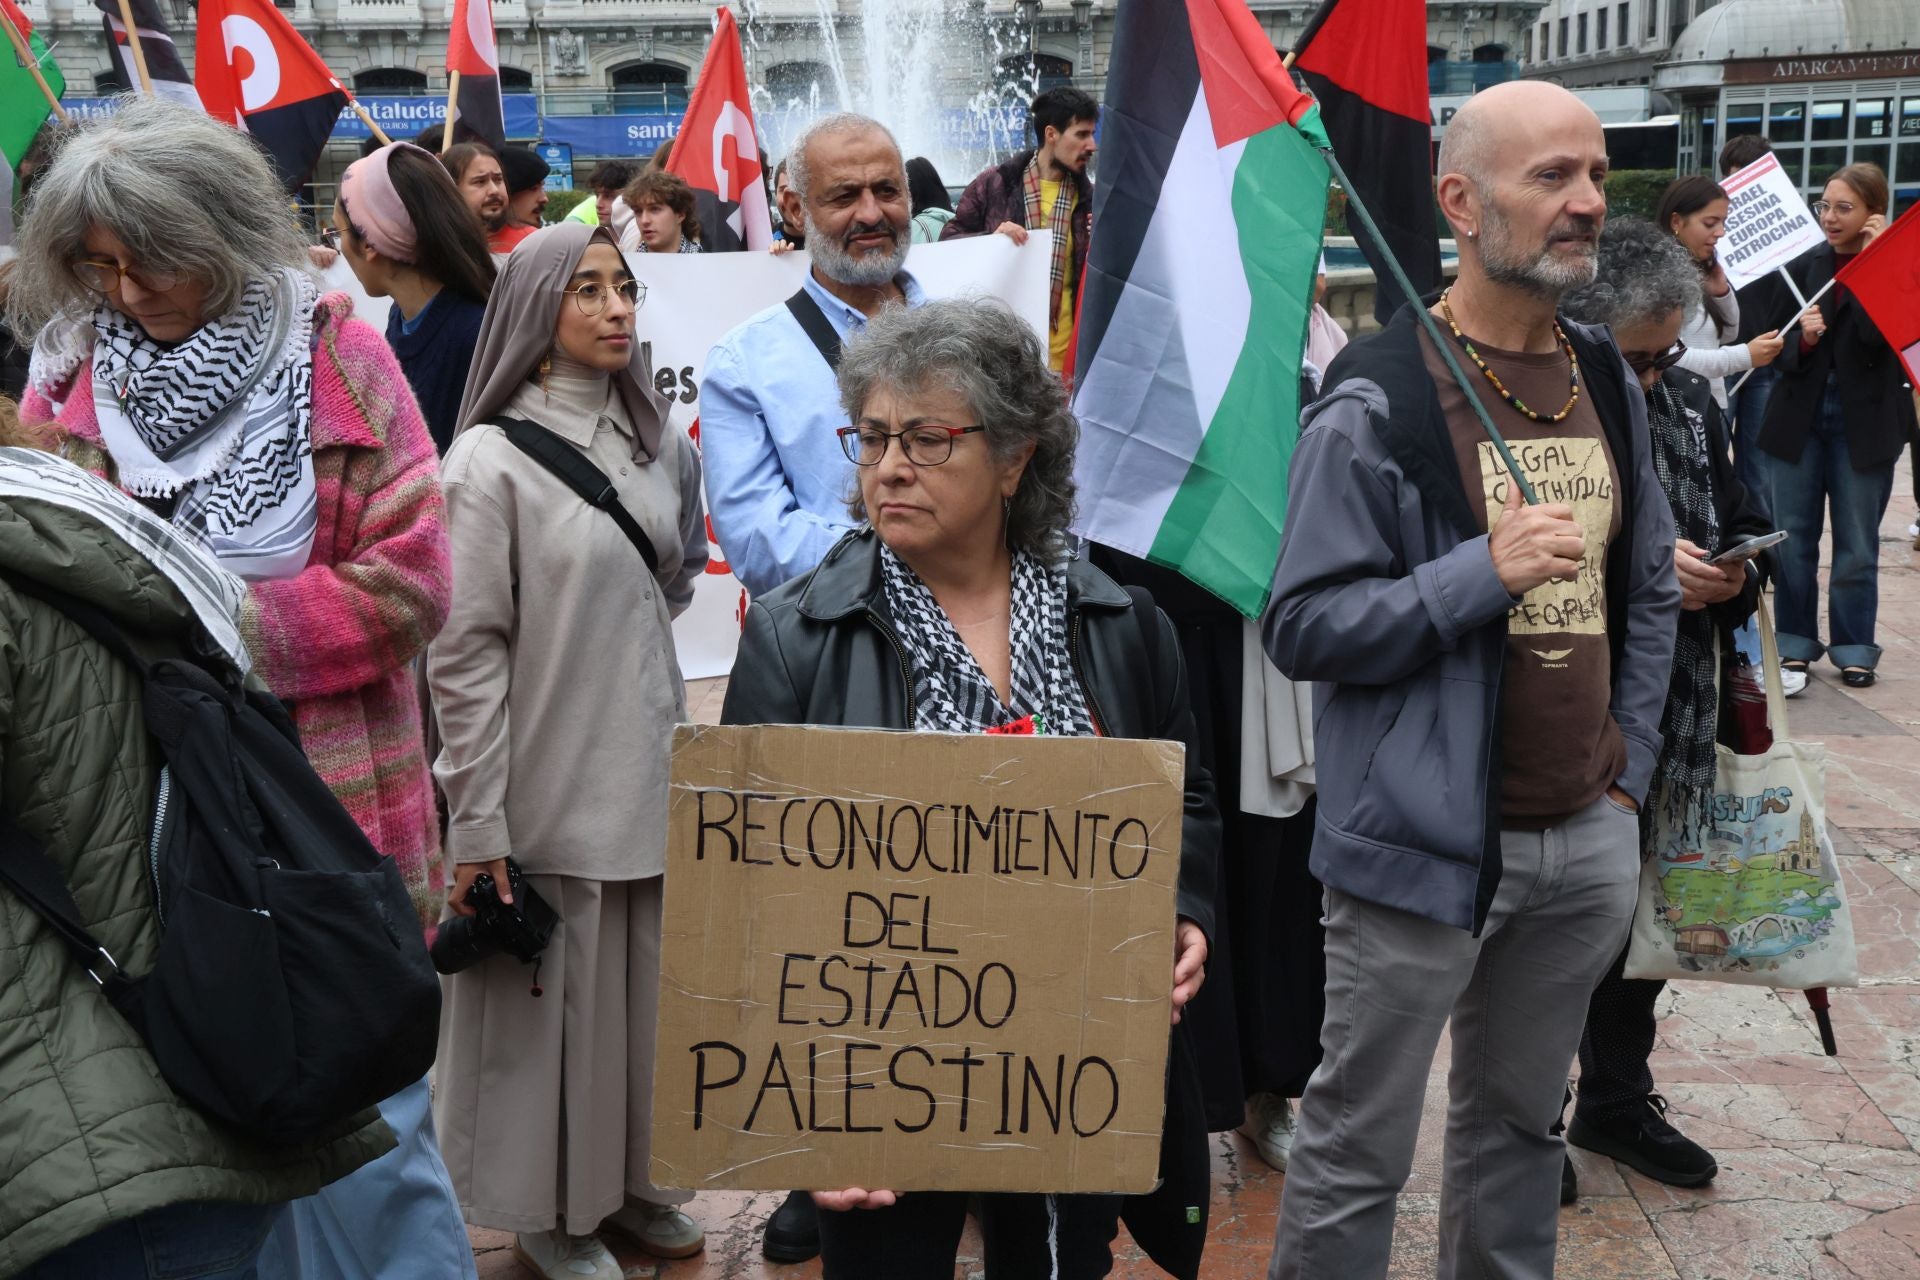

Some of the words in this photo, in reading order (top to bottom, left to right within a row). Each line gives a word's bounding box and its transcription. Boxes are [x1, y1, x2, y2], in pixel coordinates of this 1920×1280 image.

[627, 121, 682, 139] sant
[1726, 183, 1768, 214] SRAEL
[1724, 214, 1809, 268] PATROCINA
[1728, 207, 1788, 247] EUROPA
[1492, 476, 1611, 505] CTHING
[695, 789, 1150, 880] RECONOCIMIENTO
[843, 891, 959, 954] DEL
[777, 953, 1017, 1030] ESTADO
[689, 1041, 1120, 1137] PALESTINO
